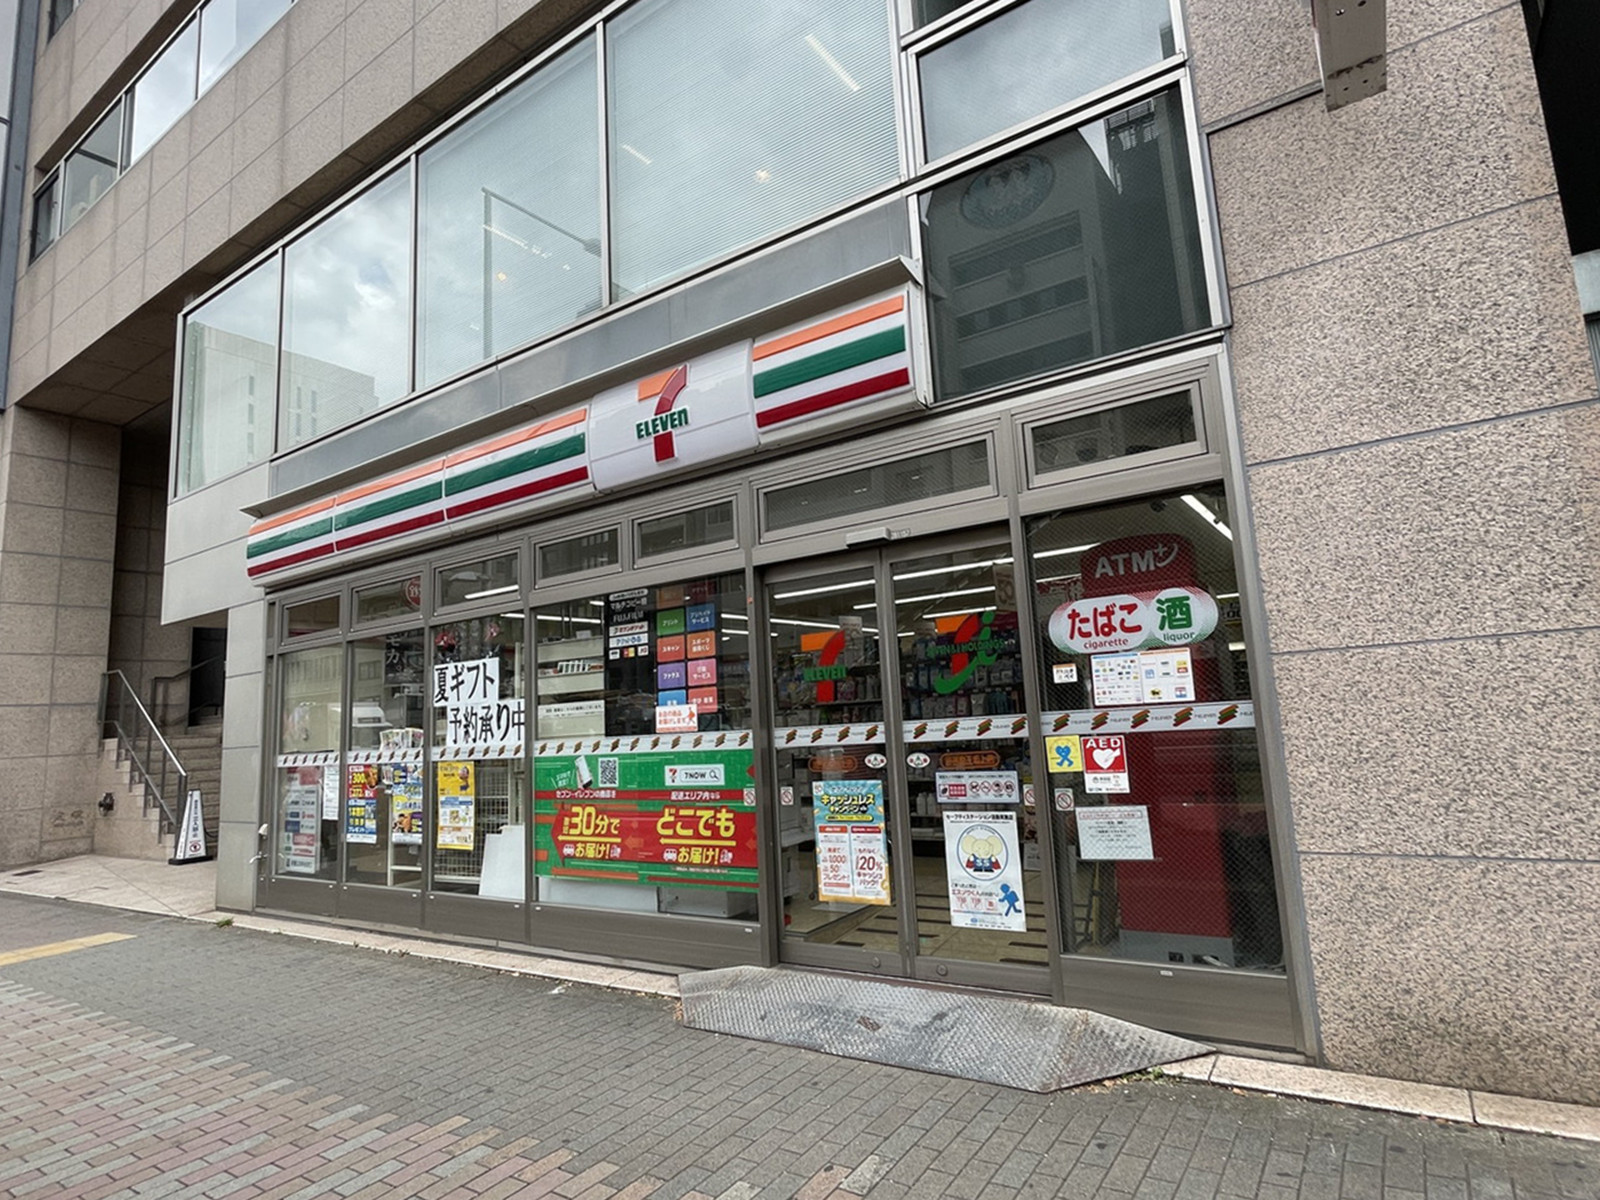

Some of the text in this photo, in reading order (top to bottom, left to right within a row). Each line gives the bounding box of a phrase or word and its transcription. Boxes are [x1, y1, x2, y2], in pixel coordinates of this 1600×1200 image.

[636, 408, 689, 439] ELEVEN
[1095, 551, 1156, 579] ATM
[1068, 595, 1193, 640] たばこ 酒
[1083, 631, 1195, 649] cigarette liquor
[434, 662, 495, 703] 夏ギフト
[449, 701, 525, 744] 予約承り中
[1086, 738, 1121, 749] AED
[684, 771, 707, 780] 7NOW
[821, 794, 876, 805] キャッシュレス
[656, 808, 735, 838] どこでも
